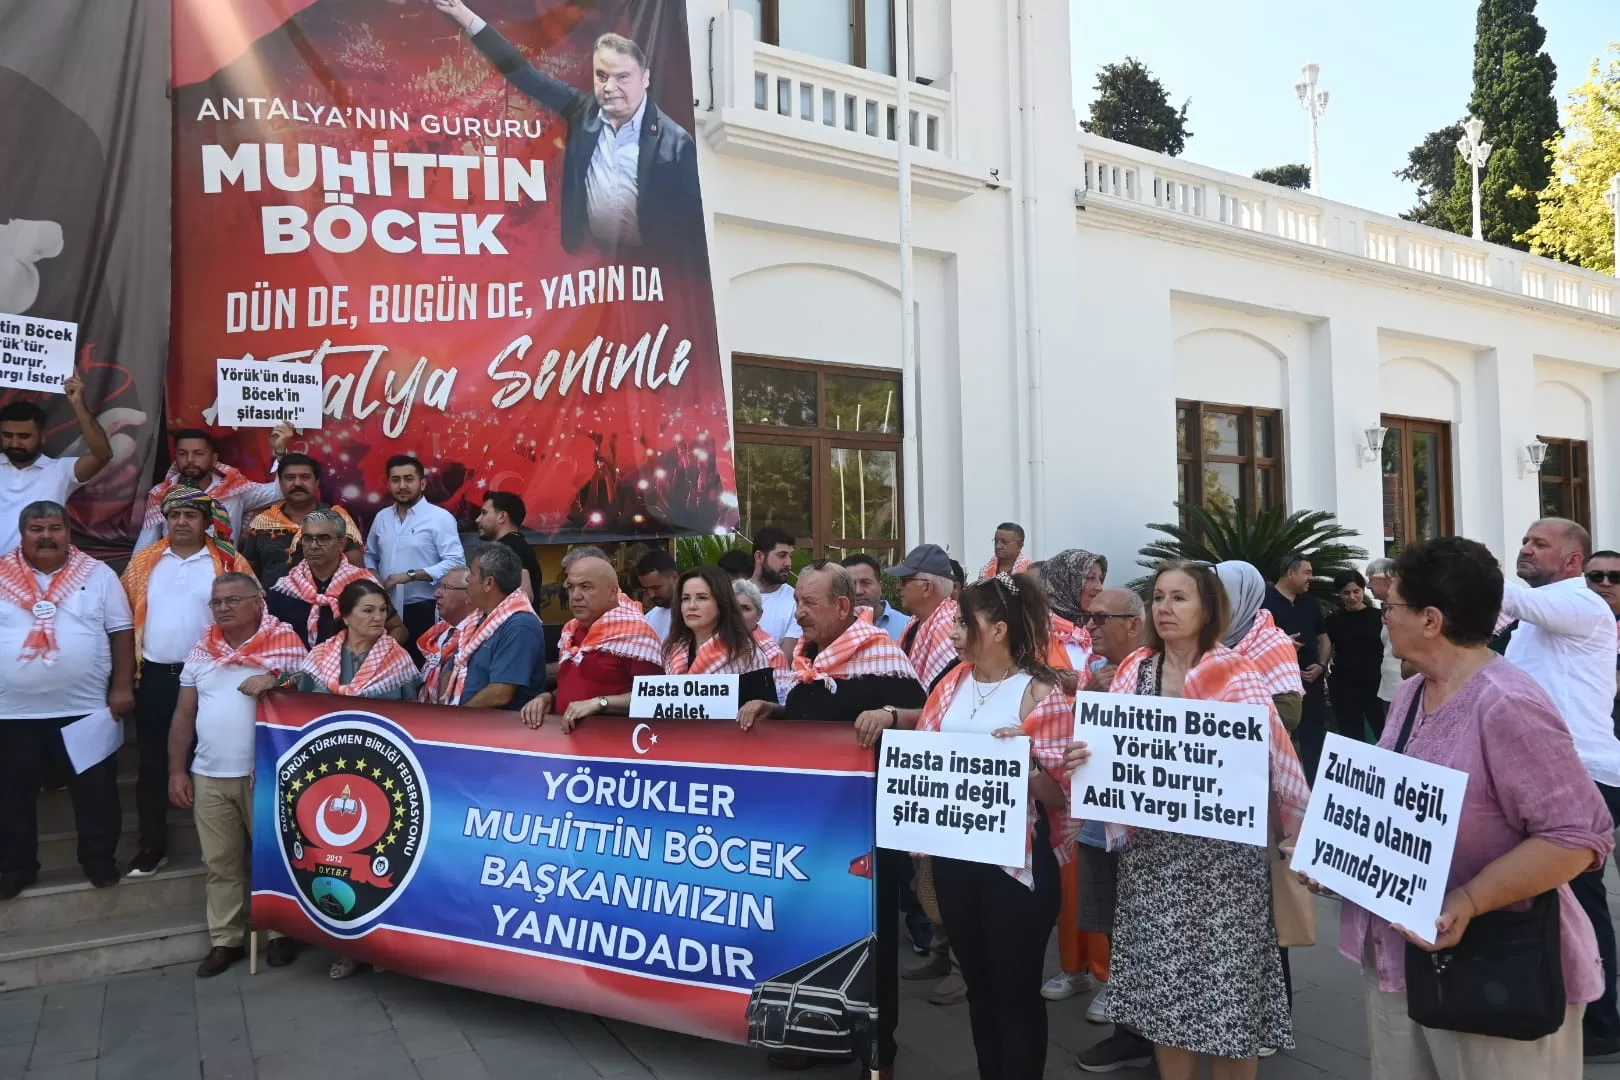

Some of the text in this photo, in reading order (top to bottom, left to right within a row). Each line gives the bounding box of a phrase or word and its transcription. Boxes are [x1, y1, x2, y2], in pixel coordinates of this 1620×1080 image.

[197, 98, 542, 139] ANTALYA'NIN GURURU
[201, 139, 547, 201] MUHİTTİN
[261, 192, 509, 255] BÖCEK
[226, 265, 664, 333] DÜN DE, BUGÜN DE, YARIN DA
[25, 323, 72, 341] Böcek
[2, 352, 46, 369] Durur,
[220, 367, 319, 386] Yörük'ün duası,
[487, 324, 692, 409] Seninle
[242, 386, 300, 402] Böcek'in
[637, 681, 730, 698] Hasta Olana
[1080, 702, 1263, 742] Muhittin Böcek
[885, 746, 1021, 778] Hasta insana
[1112, 761, 1224, 797] Dik Durur,
[309, 734, 363, 755] TÜRKMEN
[365, 737, 401, 765] BİRLİĞİ
[396, 762, 420, 857] FEDERASYONU
[542, 766, 736, 819] YÖRÜKLER
[886, 774, 1017, 810] zulüm değil,
[1083, 785, 1256, 829] Adil Yargı İster!
[1324, 752, 1448, 826] Zulmün değil,
[892, 801, 1007, 836] şifa düşer!
[1323, 793, 1433, 865] hasta olanın
[326, 854, 343, 864] 2012
[463, 807, 809, 881] MUHİTTİN BÖCEK
[480, 855, 775, 932] BAŞKANIMIZIN
[1311, 838, 1428, 906] yanındayız!"
[491, 904, 757, 981] YANINDADIR
